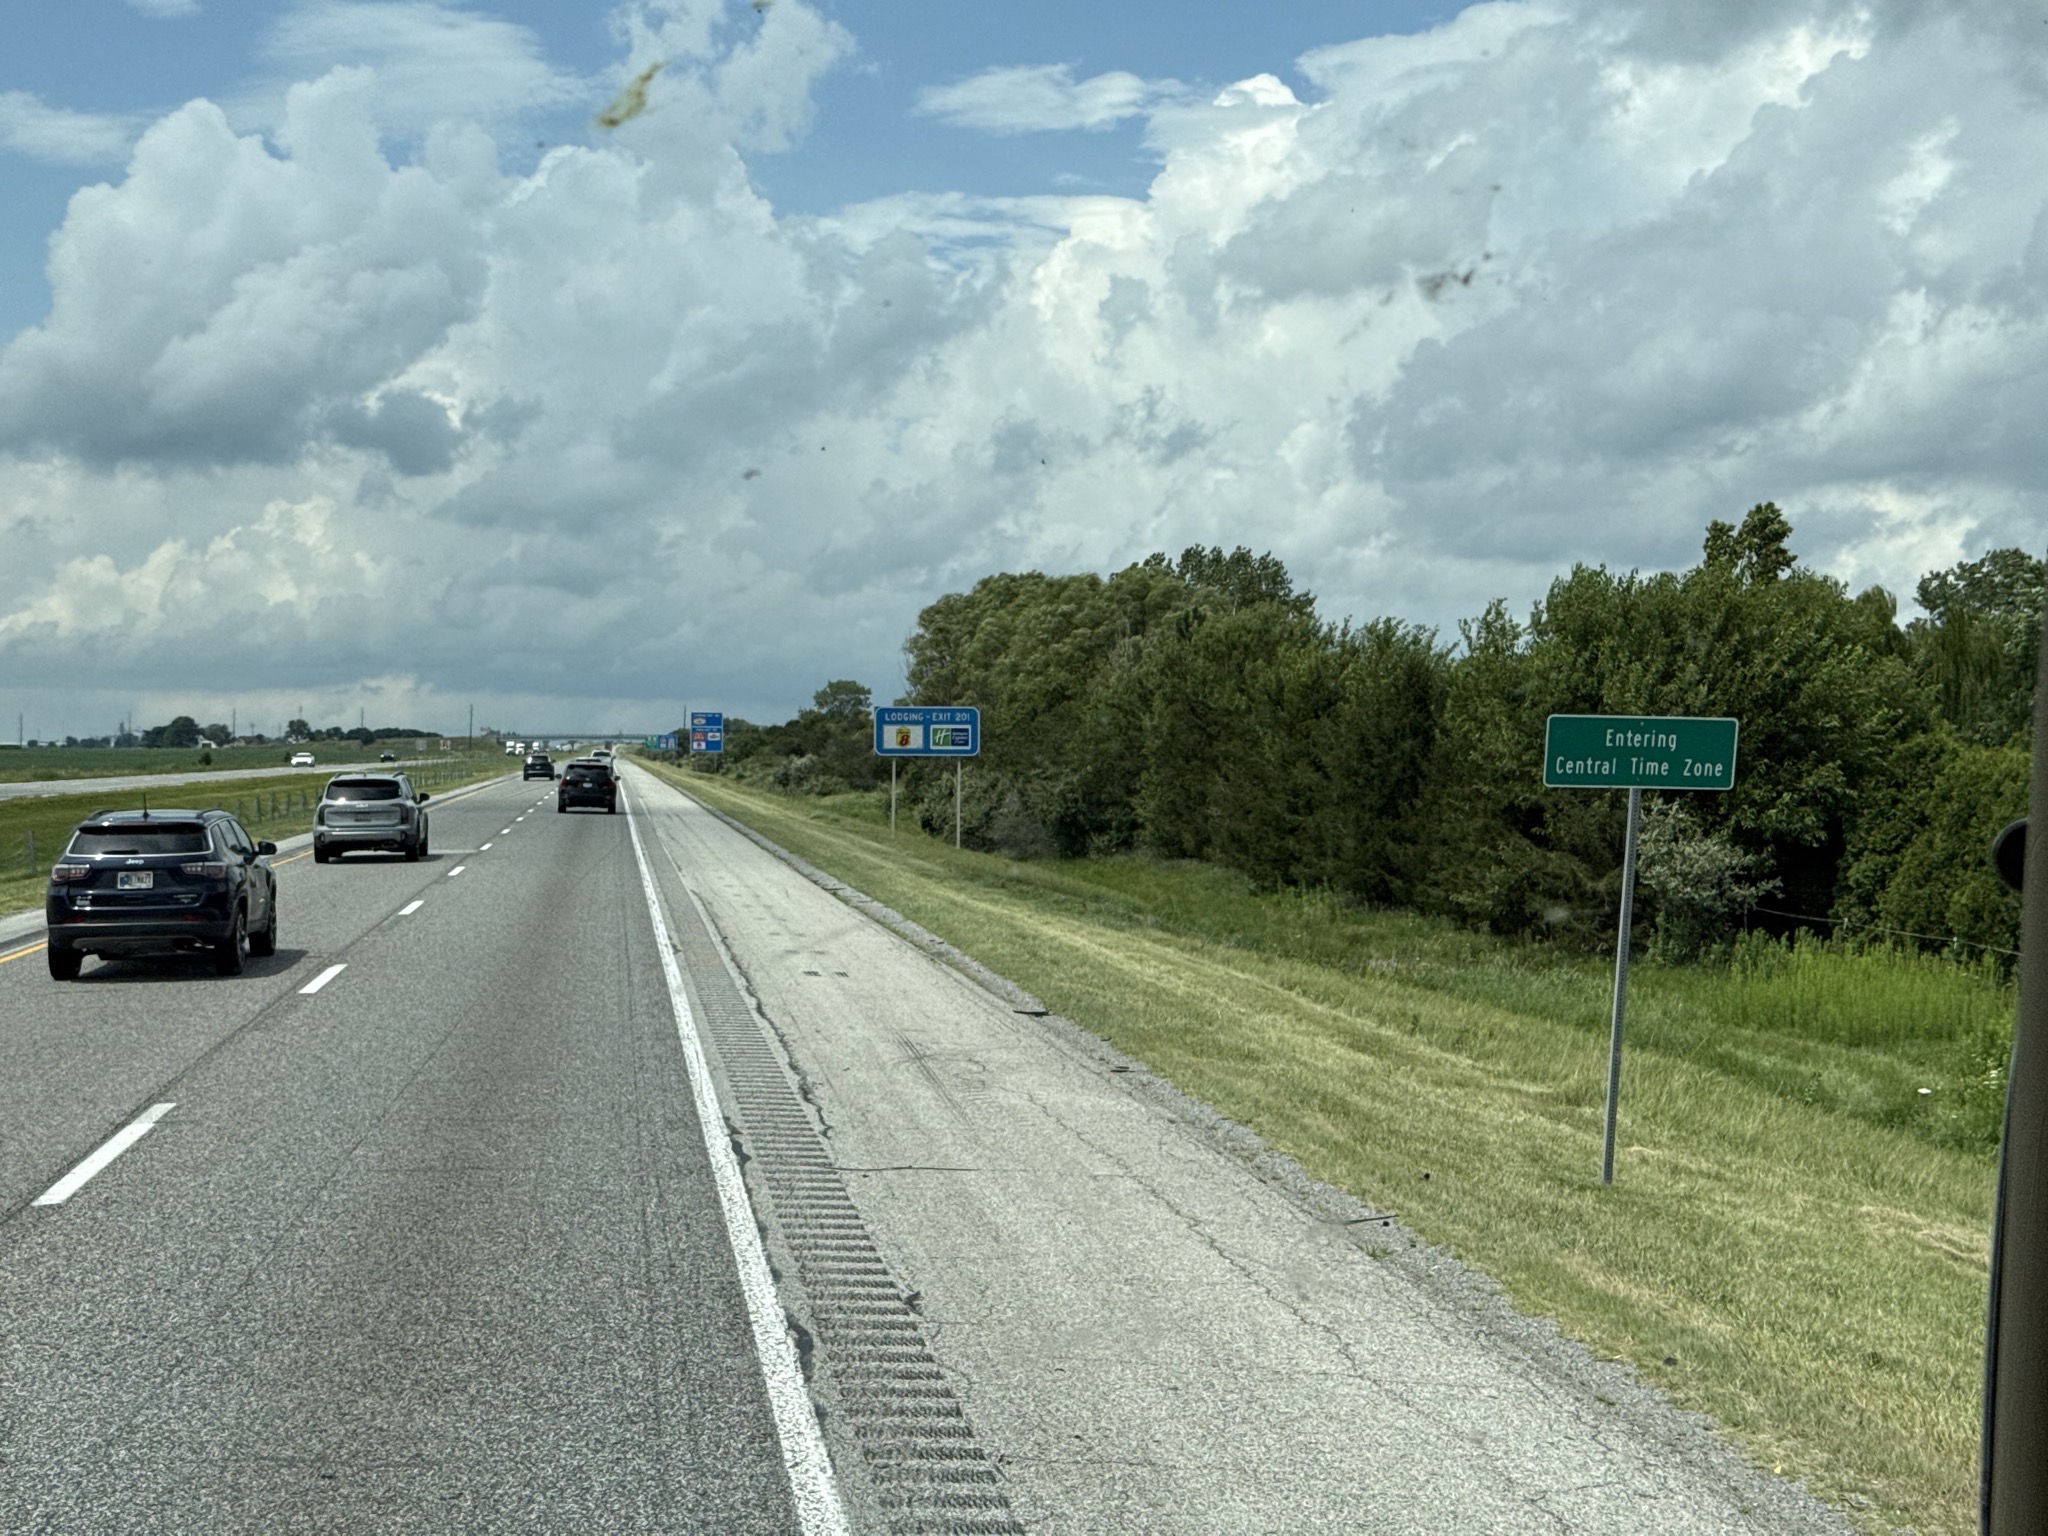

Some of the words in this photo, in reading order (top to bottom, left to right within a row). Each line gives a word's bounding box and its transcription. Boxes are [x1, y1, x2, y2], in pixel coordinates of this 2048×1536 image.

[885, 712, 924, 721] LODGING
[932, 712, 951, 721] EXIT
[955, 712, 970, 721] 201
[1605, 729, 1677, 751] Entering
[1555, 756, 1617, 775] Central
[1631, 757, 1670, 776] Time
[1682, 758, 1724, 777] Zone
